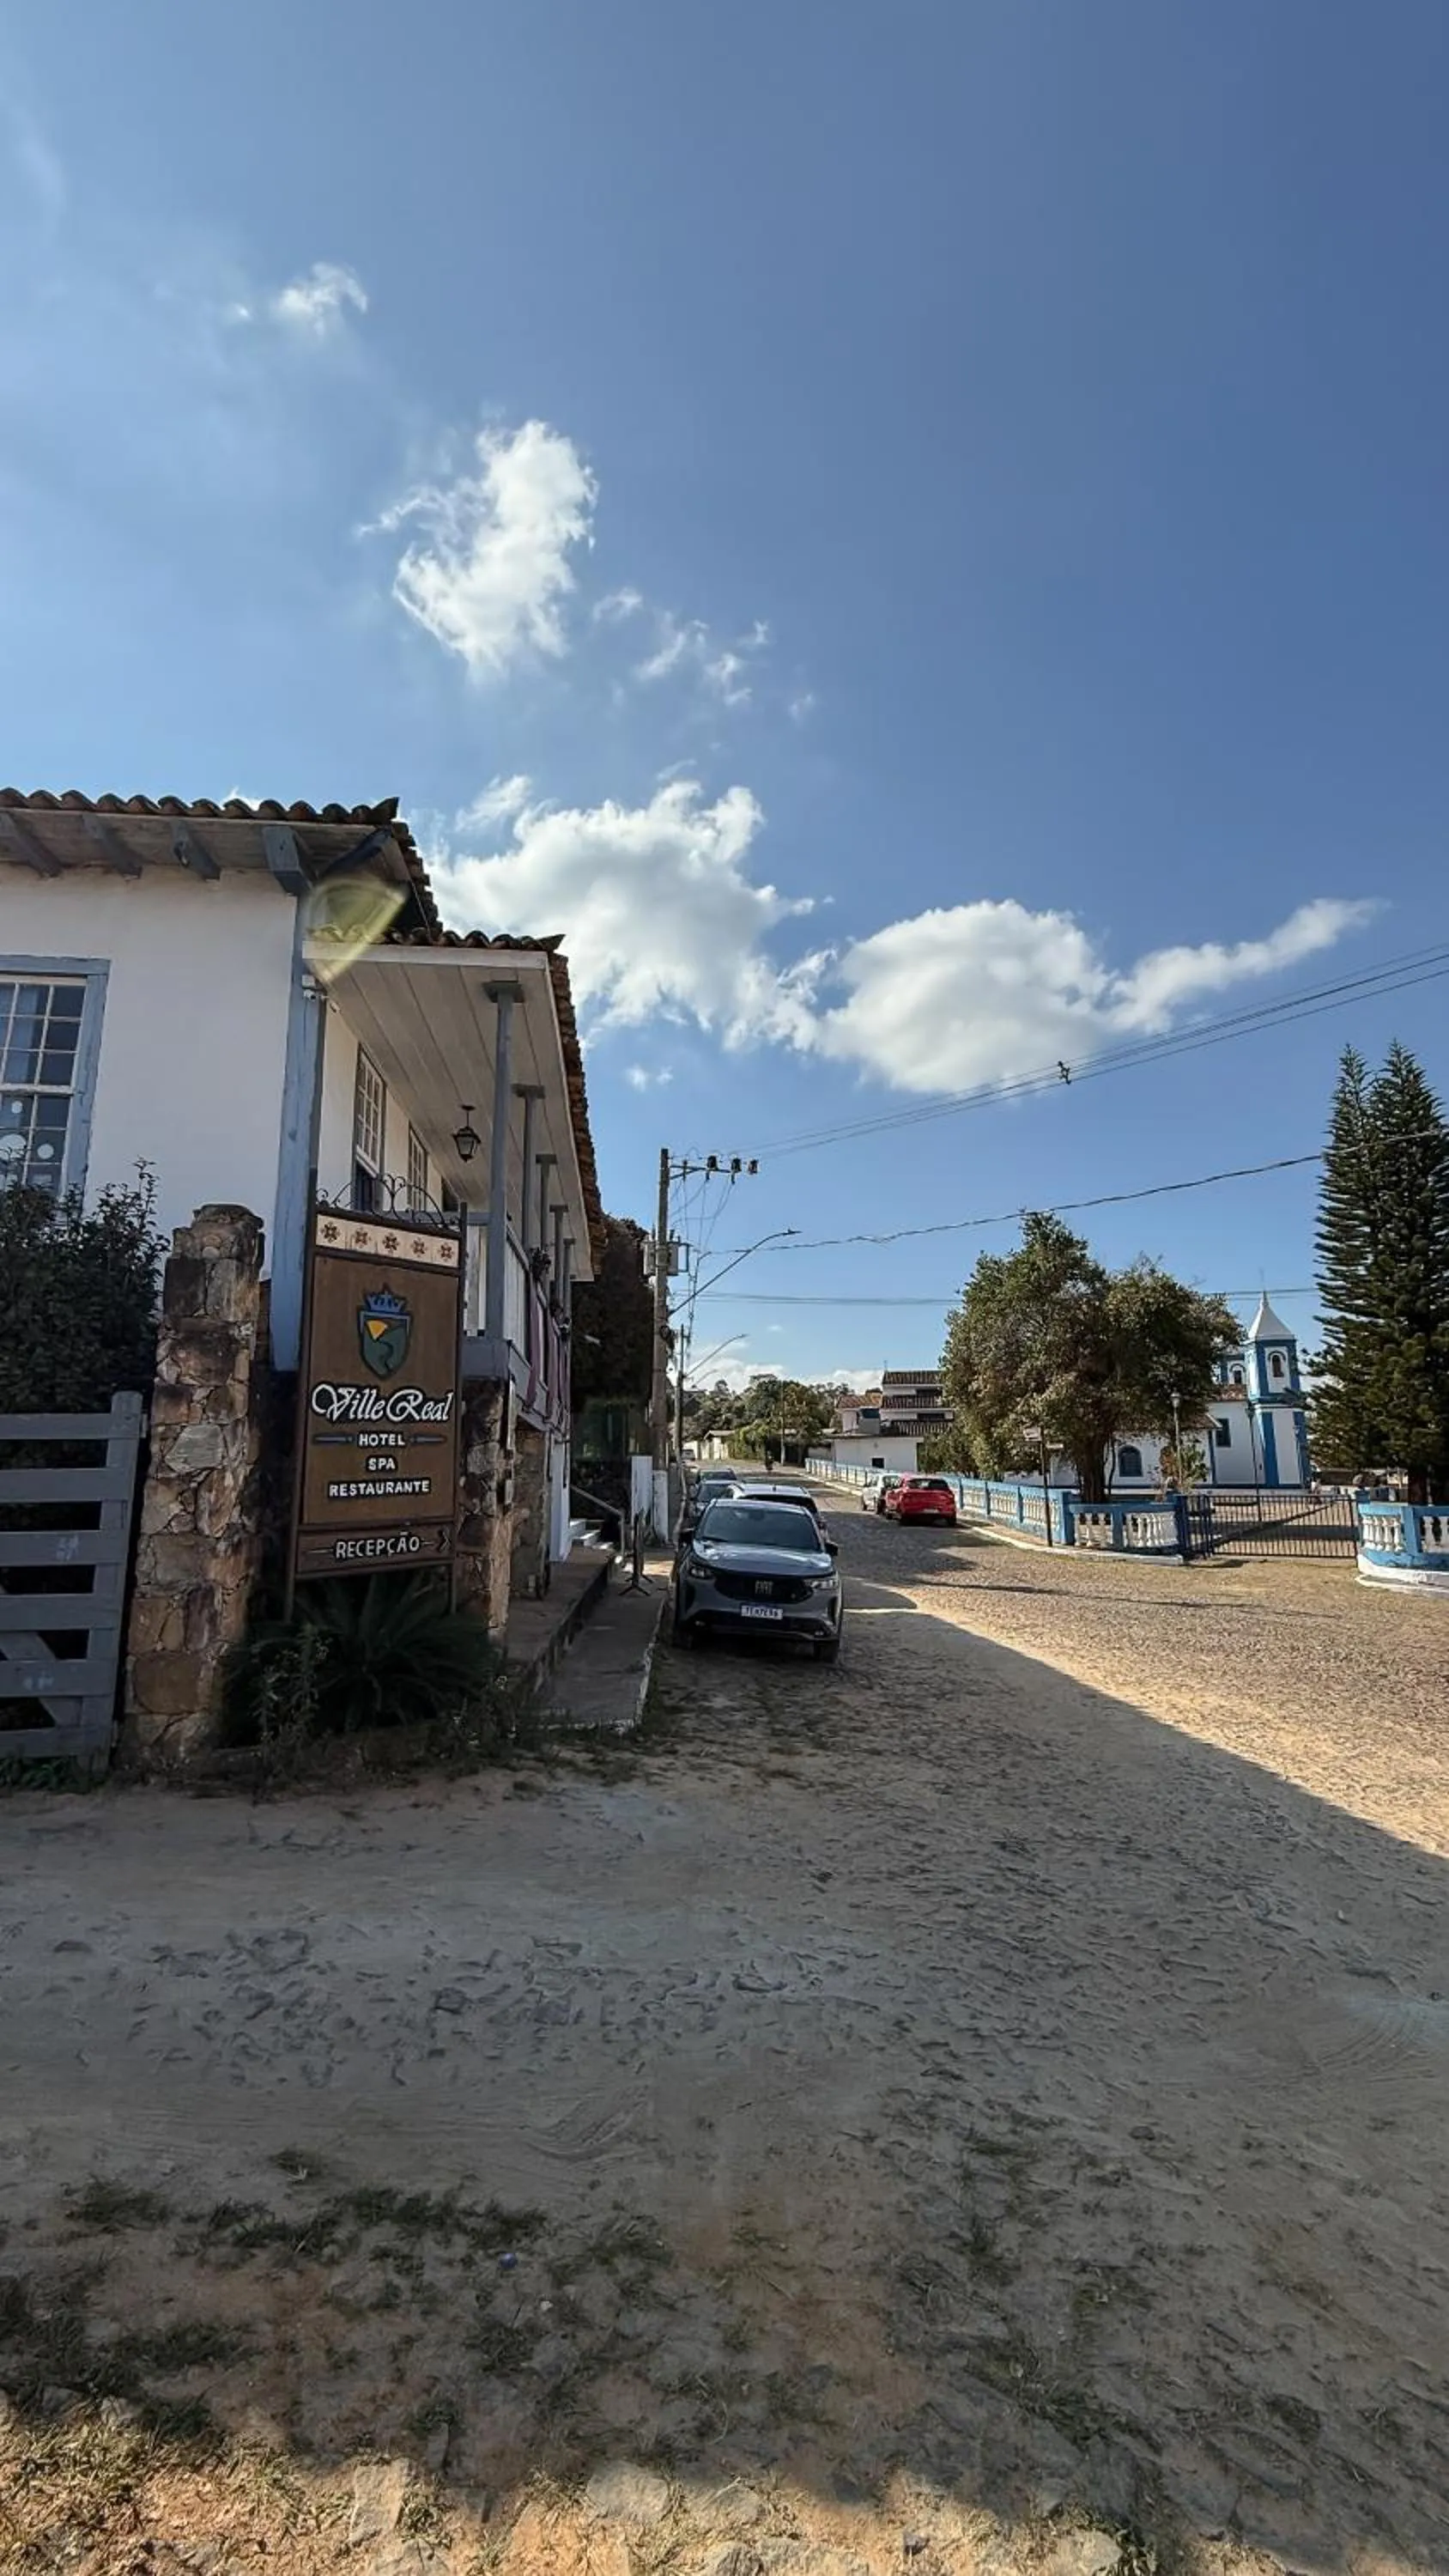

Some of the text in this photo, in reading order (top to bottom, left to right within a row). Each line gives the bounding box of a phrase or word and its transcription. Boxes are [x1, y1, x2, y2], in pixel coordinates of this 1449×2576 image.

[312, 1383, 453, 1421] Ville Real
[359, 1433, 406, 1446] HOTEL
[368, 1457, 396, 1471] SPA
[330, 1479, 430, 1497] RESTAURANTE
[336, 1531, 420, 1558] RECEPÇÃO
